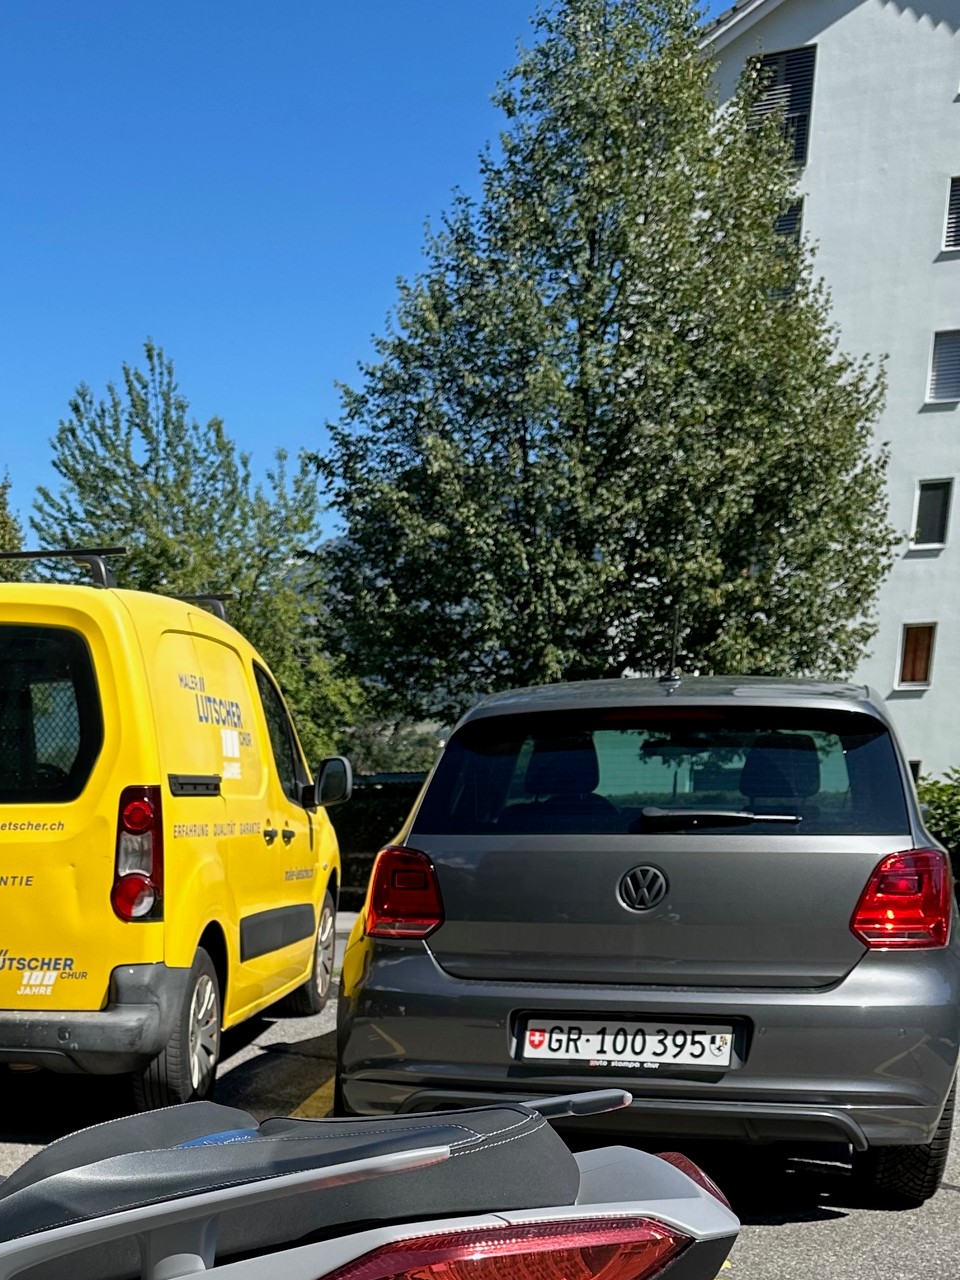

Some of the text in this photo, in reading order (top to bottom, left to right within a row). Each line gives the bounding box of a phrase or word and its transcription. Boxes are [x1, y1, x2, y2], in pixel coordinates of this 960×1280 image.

[22, 971, 87, 985] 100 CHUR
[16, 985, 53, 995] JAHRE
